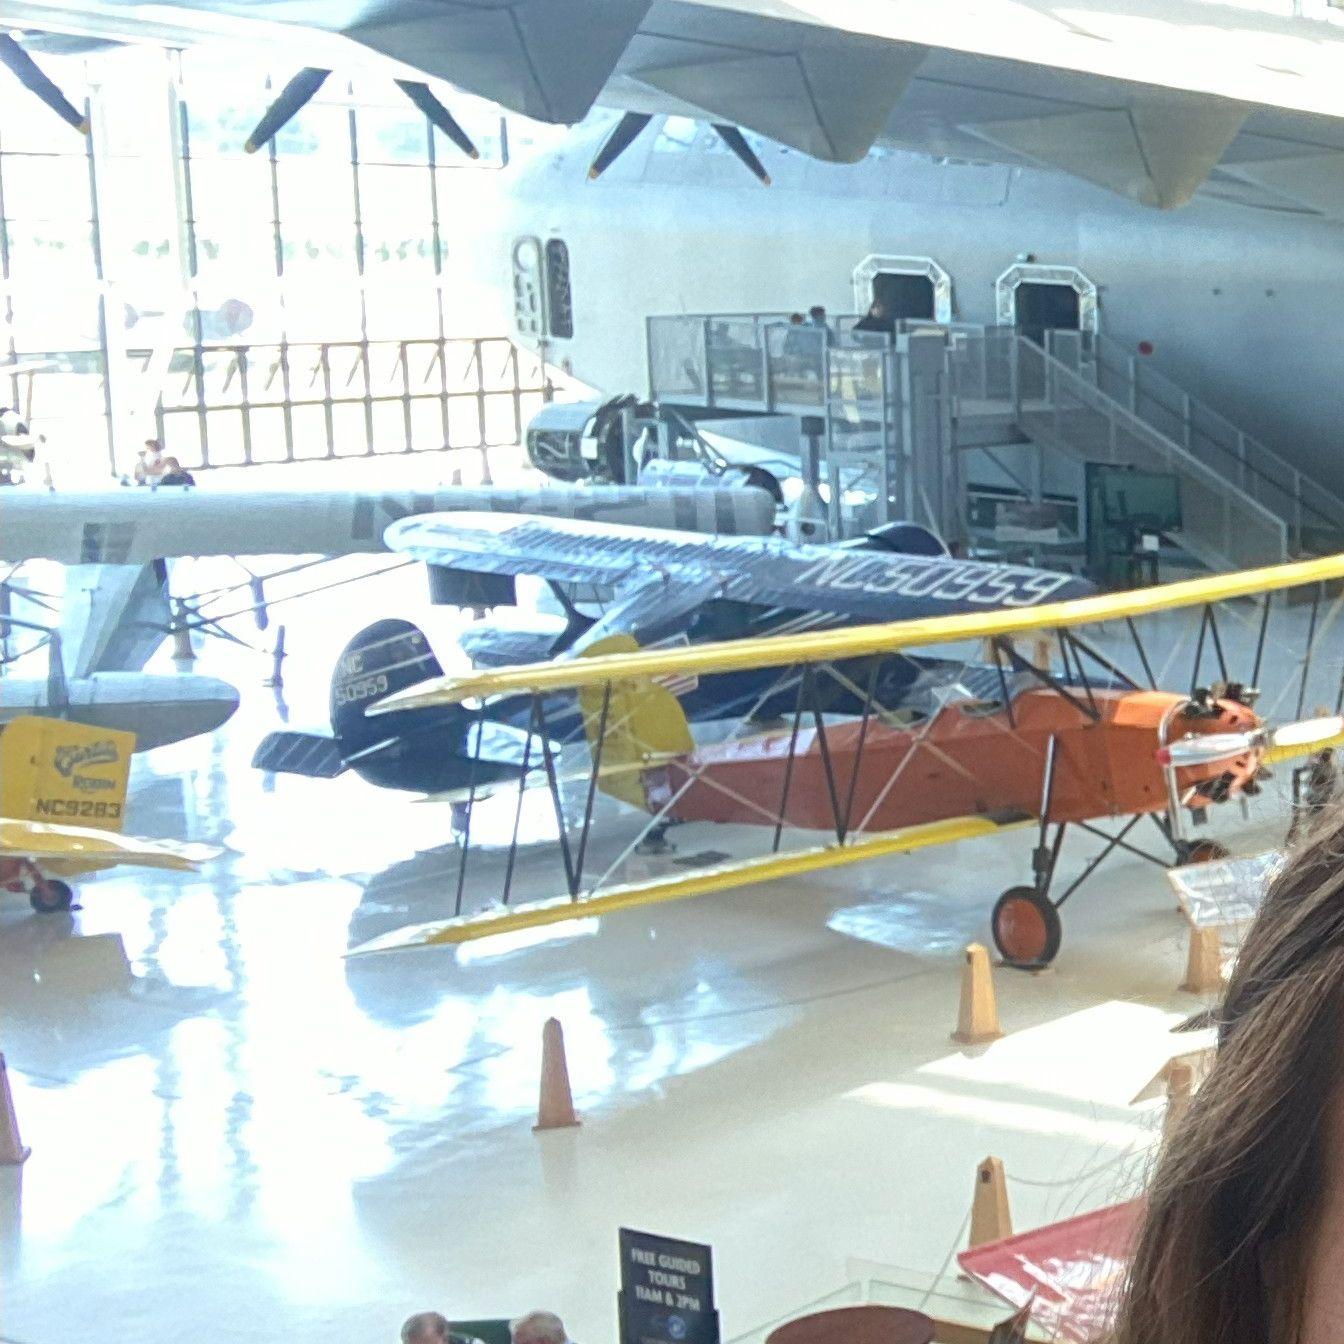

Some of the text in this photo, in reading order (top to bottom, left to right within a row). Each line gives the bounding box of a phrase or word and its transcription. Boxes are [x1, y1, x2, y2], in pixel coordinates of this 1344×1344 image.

[793, 554, 1073, 606] NC50959
[631, 1247, 700, 1275] FREE GUIDED
[648, 1269, 686, 1290] TOURS
[635, 1285, 663, 1304] 11AM
